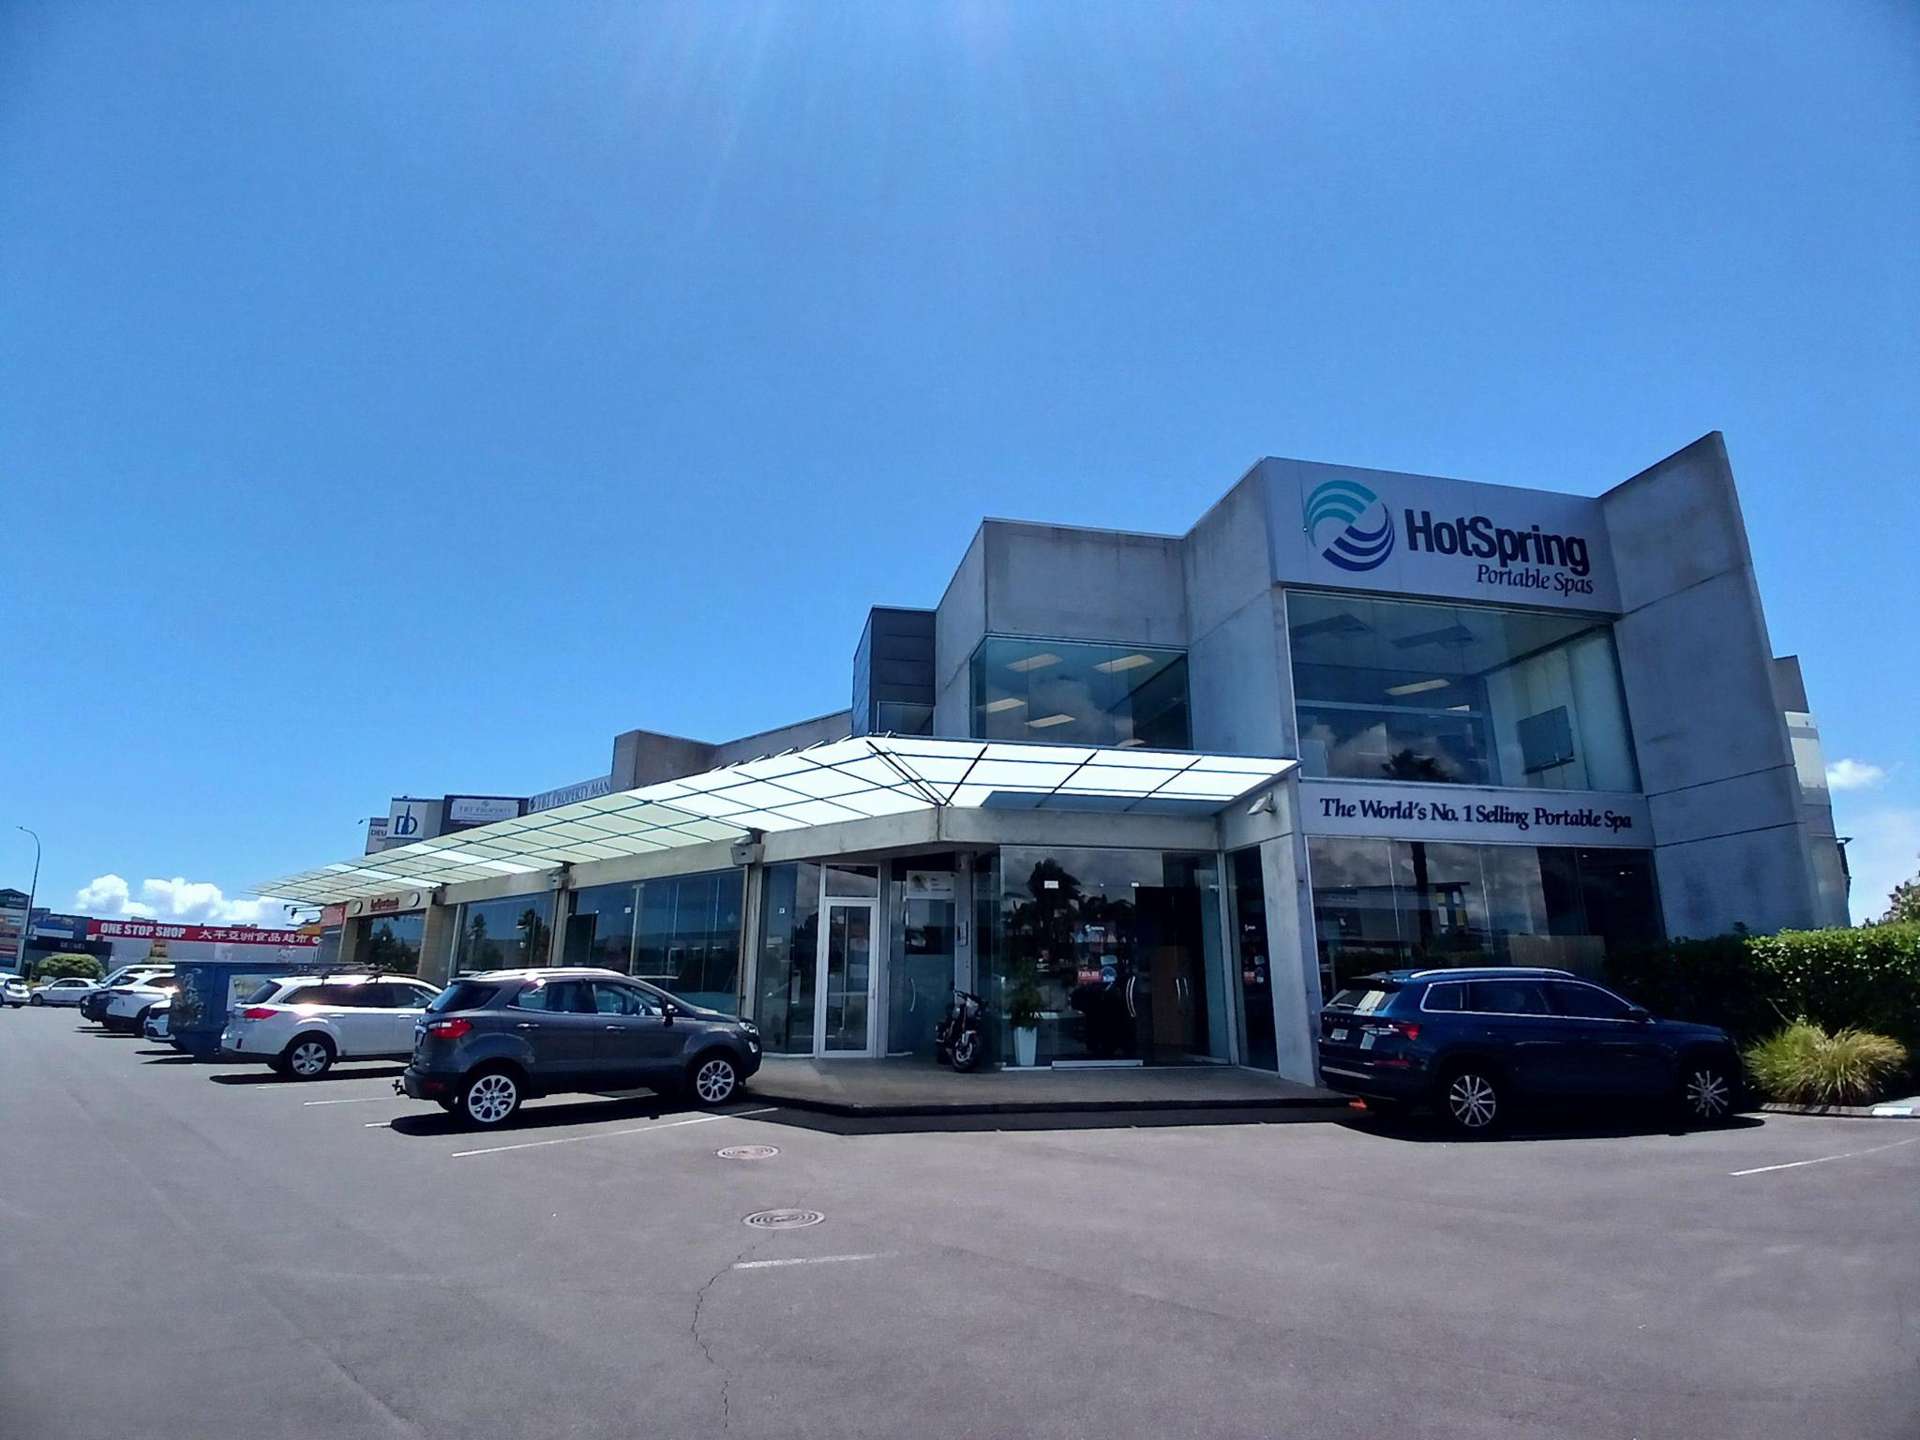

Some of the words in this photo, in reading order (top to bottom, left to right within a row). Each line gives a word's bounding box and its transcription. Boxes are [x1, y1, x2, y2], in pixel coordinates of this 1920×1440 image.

[1404, 508, 1591, 577] HotSpring
[1477, 563, 1550, 590] Portable
[1554, 572, 1594, 597] Spas
[1320, 798, 1356, 818] The
[1359, 800, 1426, 821] World's
[1430, 803, 1458, 822] No.
[1465, 804, 1472, 823] 1
[1476, 804, 1529, 831] Selling
[1534, 807, 1601, 828] Portable
[1604, 811, 1632, 834] Spa
[100, 922, 123, 935] ONE
[124, 924, 154, 937] STOP
[156, 926, 186, 938] SHOP
